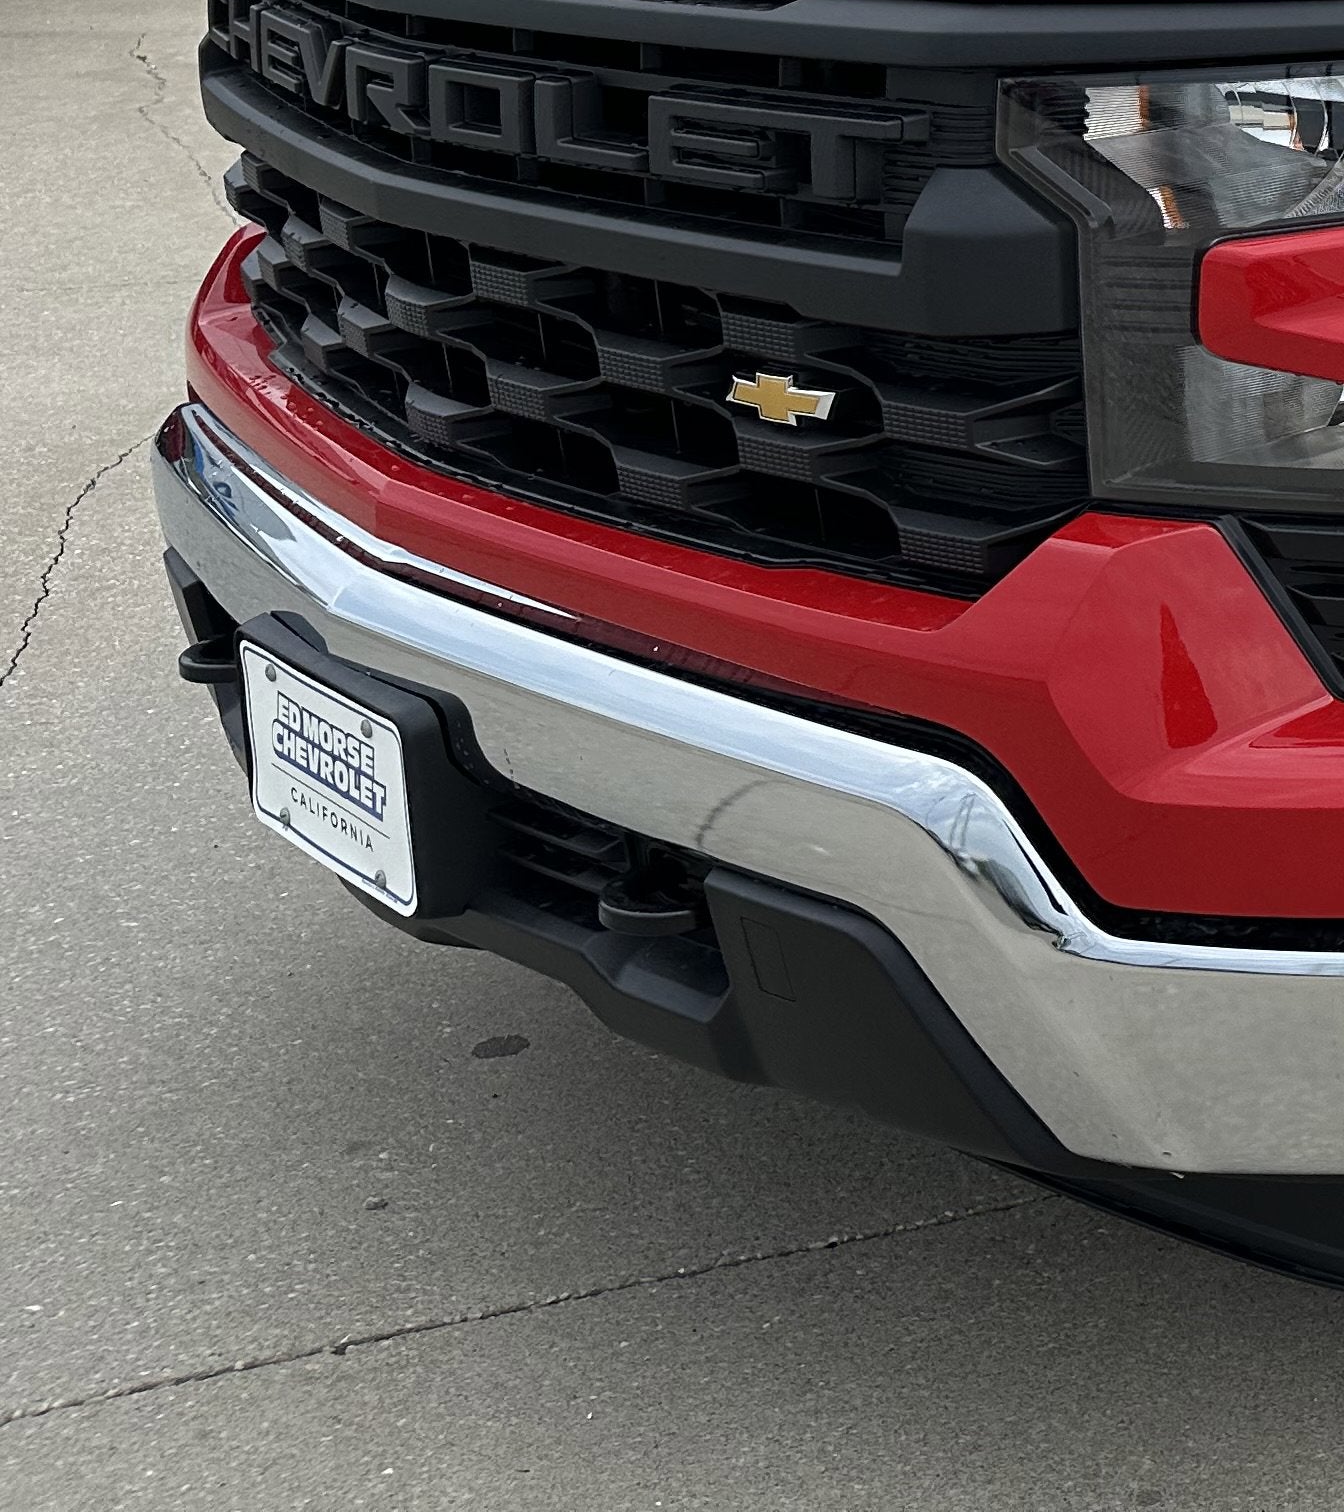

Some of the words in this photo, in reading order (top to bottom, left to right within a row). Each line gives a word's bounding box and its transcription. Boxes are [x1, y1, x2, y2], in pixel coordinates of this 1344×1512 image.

[272, 719, 387, 822] CHEVROLET
[277, 691, 301, 733] ED
[301, 706, 375, 777] MORSE
[290, 787, 374, 852] CALIFORNIA
